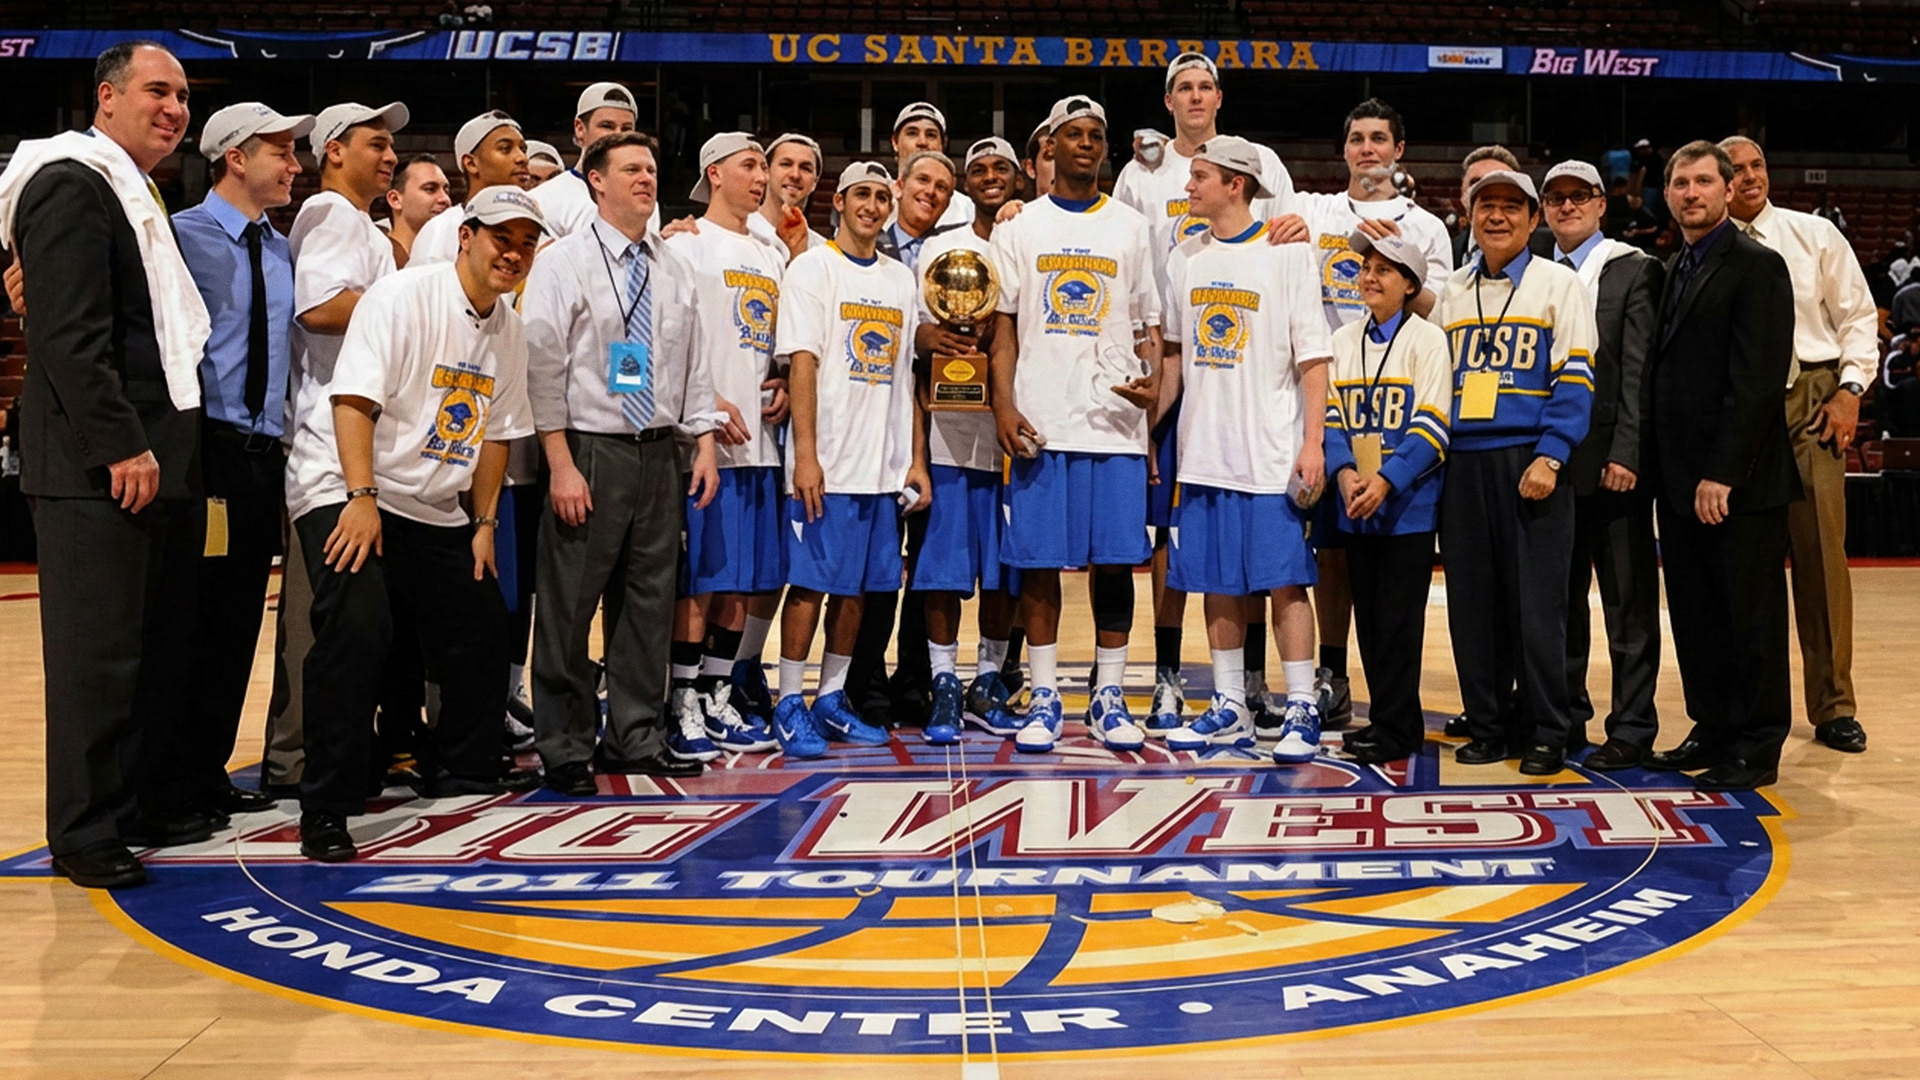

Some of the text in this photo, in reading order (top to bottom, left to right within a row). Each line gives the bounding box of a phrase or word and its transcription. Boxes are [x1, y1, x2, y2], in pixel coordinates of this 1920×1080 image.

[453, 30, 613, 60] UCSB
[769, 33, 840, 63] UC
[864, 34, 1041, 65] SANTA
[796, 776, 1728, 860] WEST
[360, 857, 1550, 893] 2011 TOURNAMENT
[201, 888, 1692, 1036] HONDA CENTER ANAHEIM
